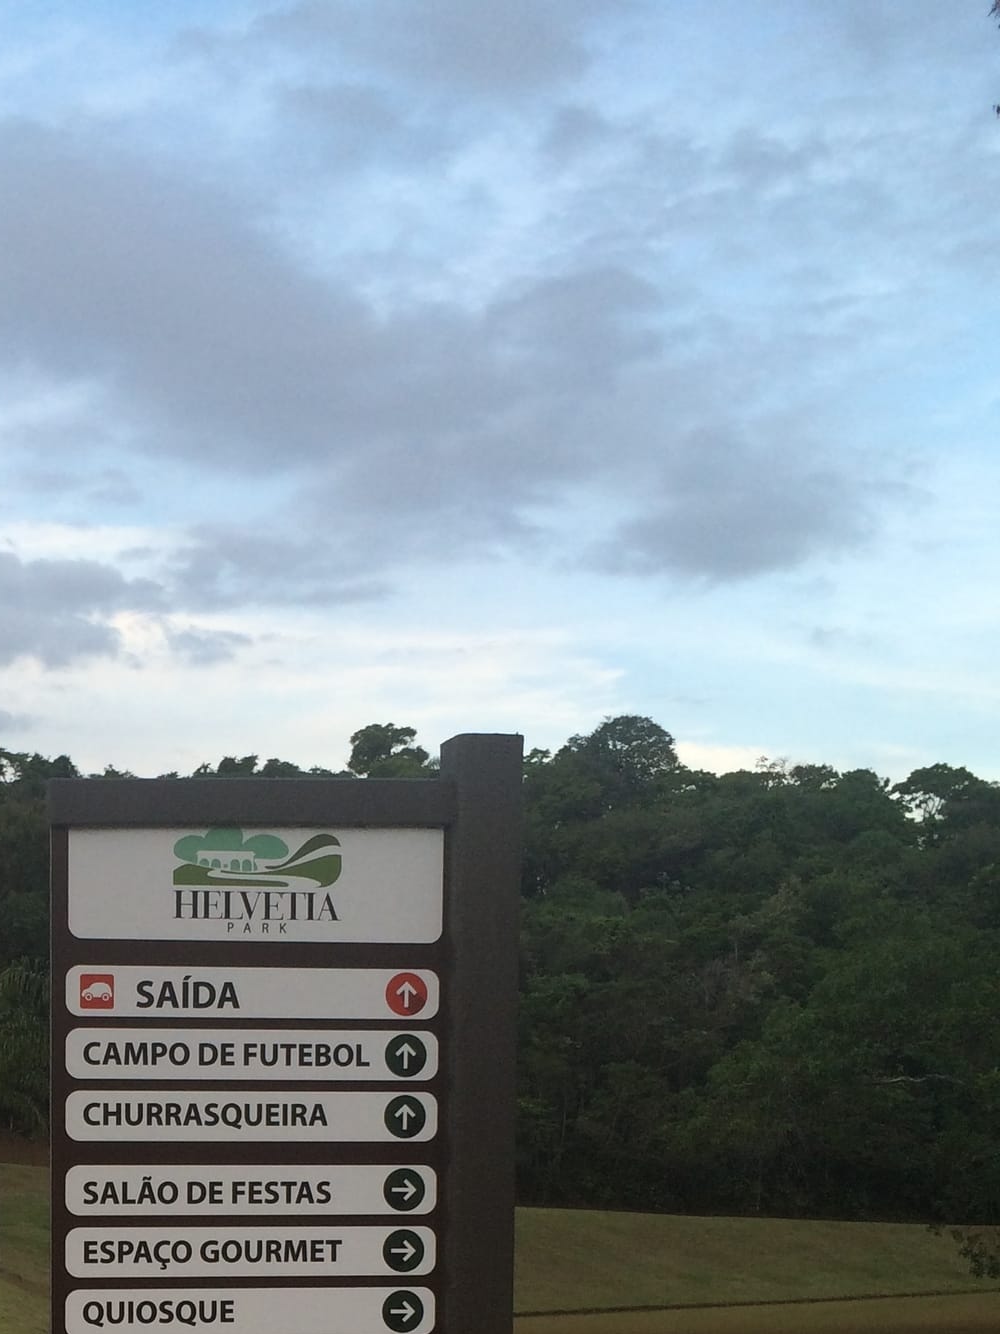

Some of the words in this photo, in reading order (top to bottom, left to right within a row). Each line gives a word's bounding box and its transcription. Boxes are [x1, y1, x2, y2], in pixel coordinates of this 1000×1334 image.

[173, 890, 342, 921] HELVETIA
[226, 922, 288, 934] PARK
[136, 975, 240, 1009] SAÍDA
[83, 1041, 190, 1066] CAMPO
[198, 1042, 235, 1066] DE
[243, 1043, 370, 1067] FUTEBOL
[83, 1102, 328, 1129] CHURRASQUEIRA
[82, 1176, 179, 1205] SALÃO
[186, 1181, 223, 1205] DE
[231, 1181, 332, 1205] FESTAS
[83, 1240, 193, 1270] ESPAÇO
[200, 1239, 343, 1263] GOURMET
[82, 1300, 235, 1327] QUIOSQUE
